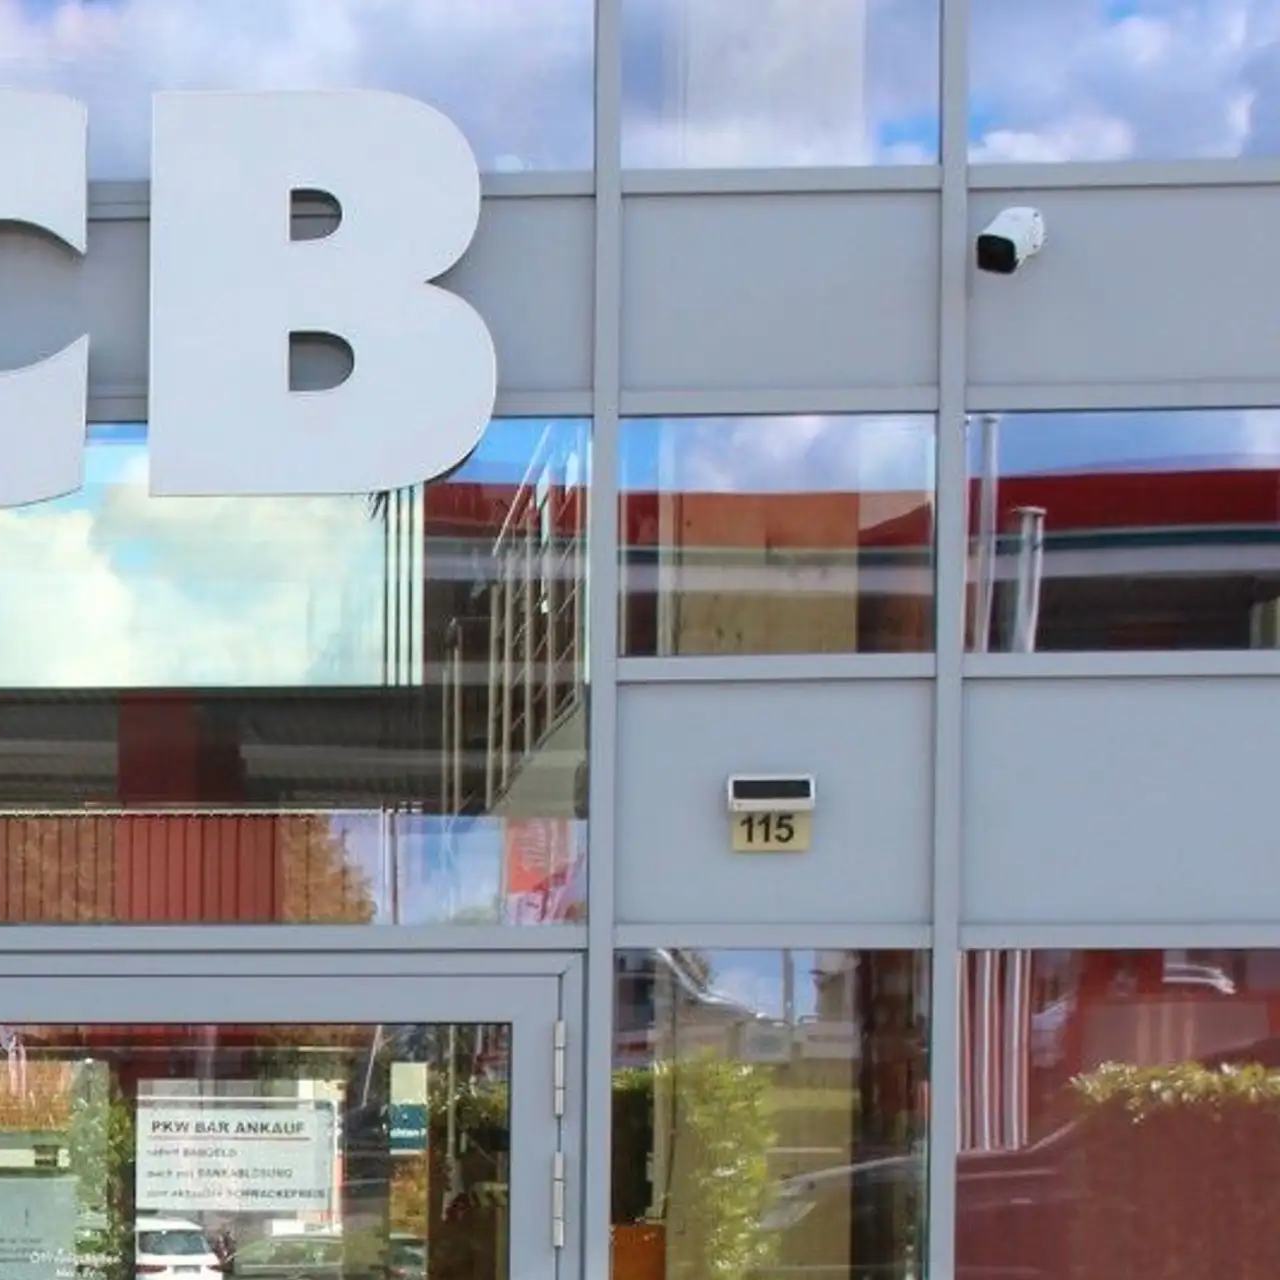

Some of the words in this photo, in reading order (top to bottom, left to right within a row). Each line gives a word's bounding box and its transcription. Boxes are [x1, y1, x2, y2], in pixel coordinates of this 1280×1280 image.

[740, 813, 794, 843] 115
[151, 1120, 190, 1134] PKW
[194, 1120, 230, 1134] BAR
[234, 1120, 306, 1134] ANKAUF
